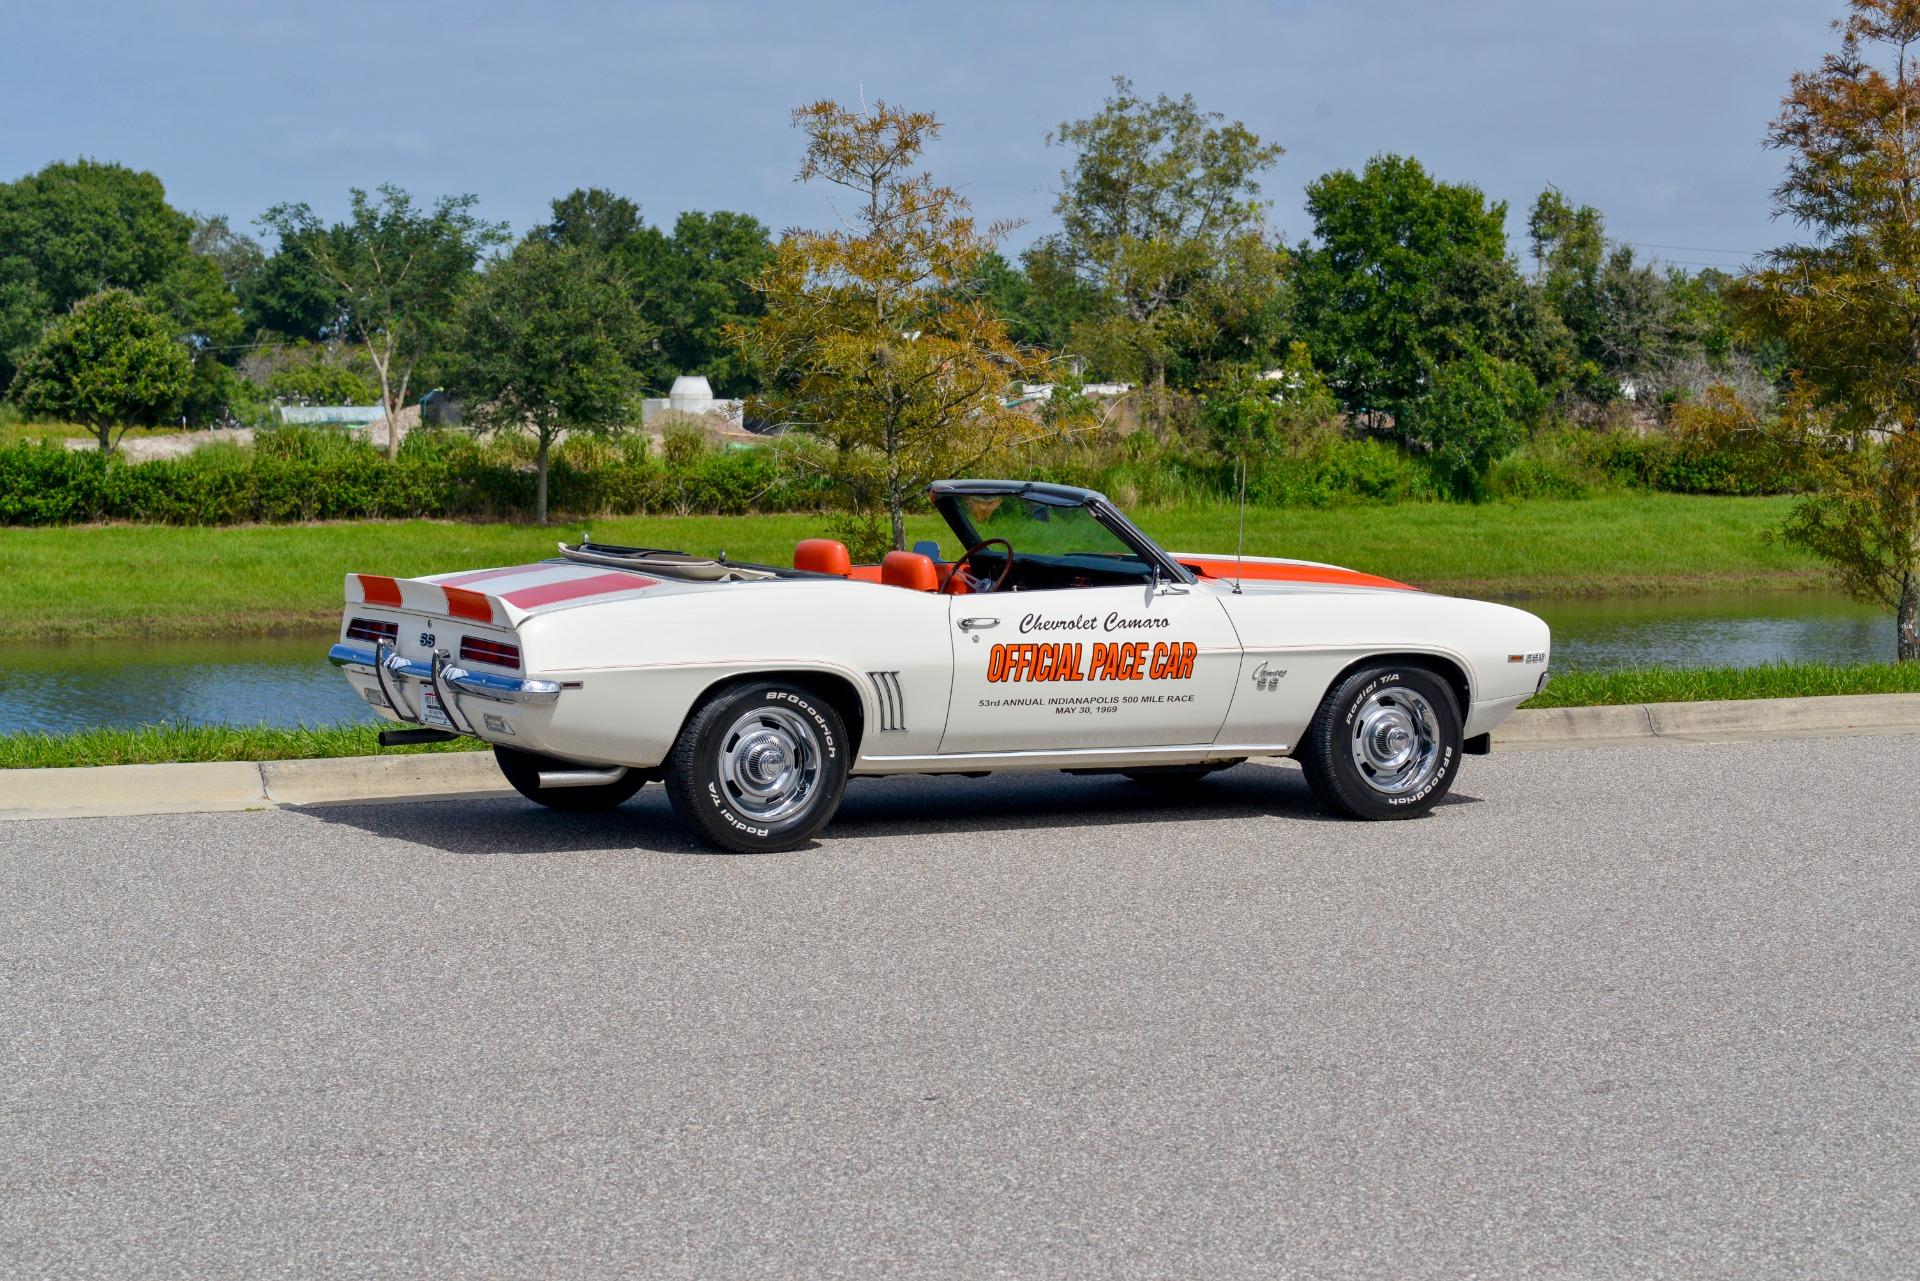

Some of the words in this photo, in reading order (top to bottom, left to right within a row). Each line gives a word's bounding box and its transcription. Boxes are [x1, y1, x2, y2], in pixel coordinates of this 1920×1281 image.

[1019, 613, 1097, 634] Chevrolet
[1103, 612, 1170, 632] Camaro
[420, 632, 435, 648] SS
[987, 643, 1084, 683] OFFICIAL
[1088, 642, 1149, 681] PACE
[1150, 642, 1198, 680] CAR
[978, 699, 1001, 707] 53rd
[1002, 698, 1045, 706] ANNUAL
[1048, 696, 1120, 705] INDIANAPOLIS
[1122, 696, 1139, 704] 500
[1141, 695, 1165, 703] MILE
[1166, 694, 1196, 703] RACE
[1079, 706, 1093, 715] 30,
[1096, 705, 1118, 714] 1969
[1346, 681, 1377, 725] Radial
[1380, 673, 1400, 684] T/A
[767, 691, 836, 758] BFGoodrich
[1388, 745, 1453, 806] BFGoodrich
[708, 781, 721, 807] T/A
[720, 808, 769, 837] Radial
